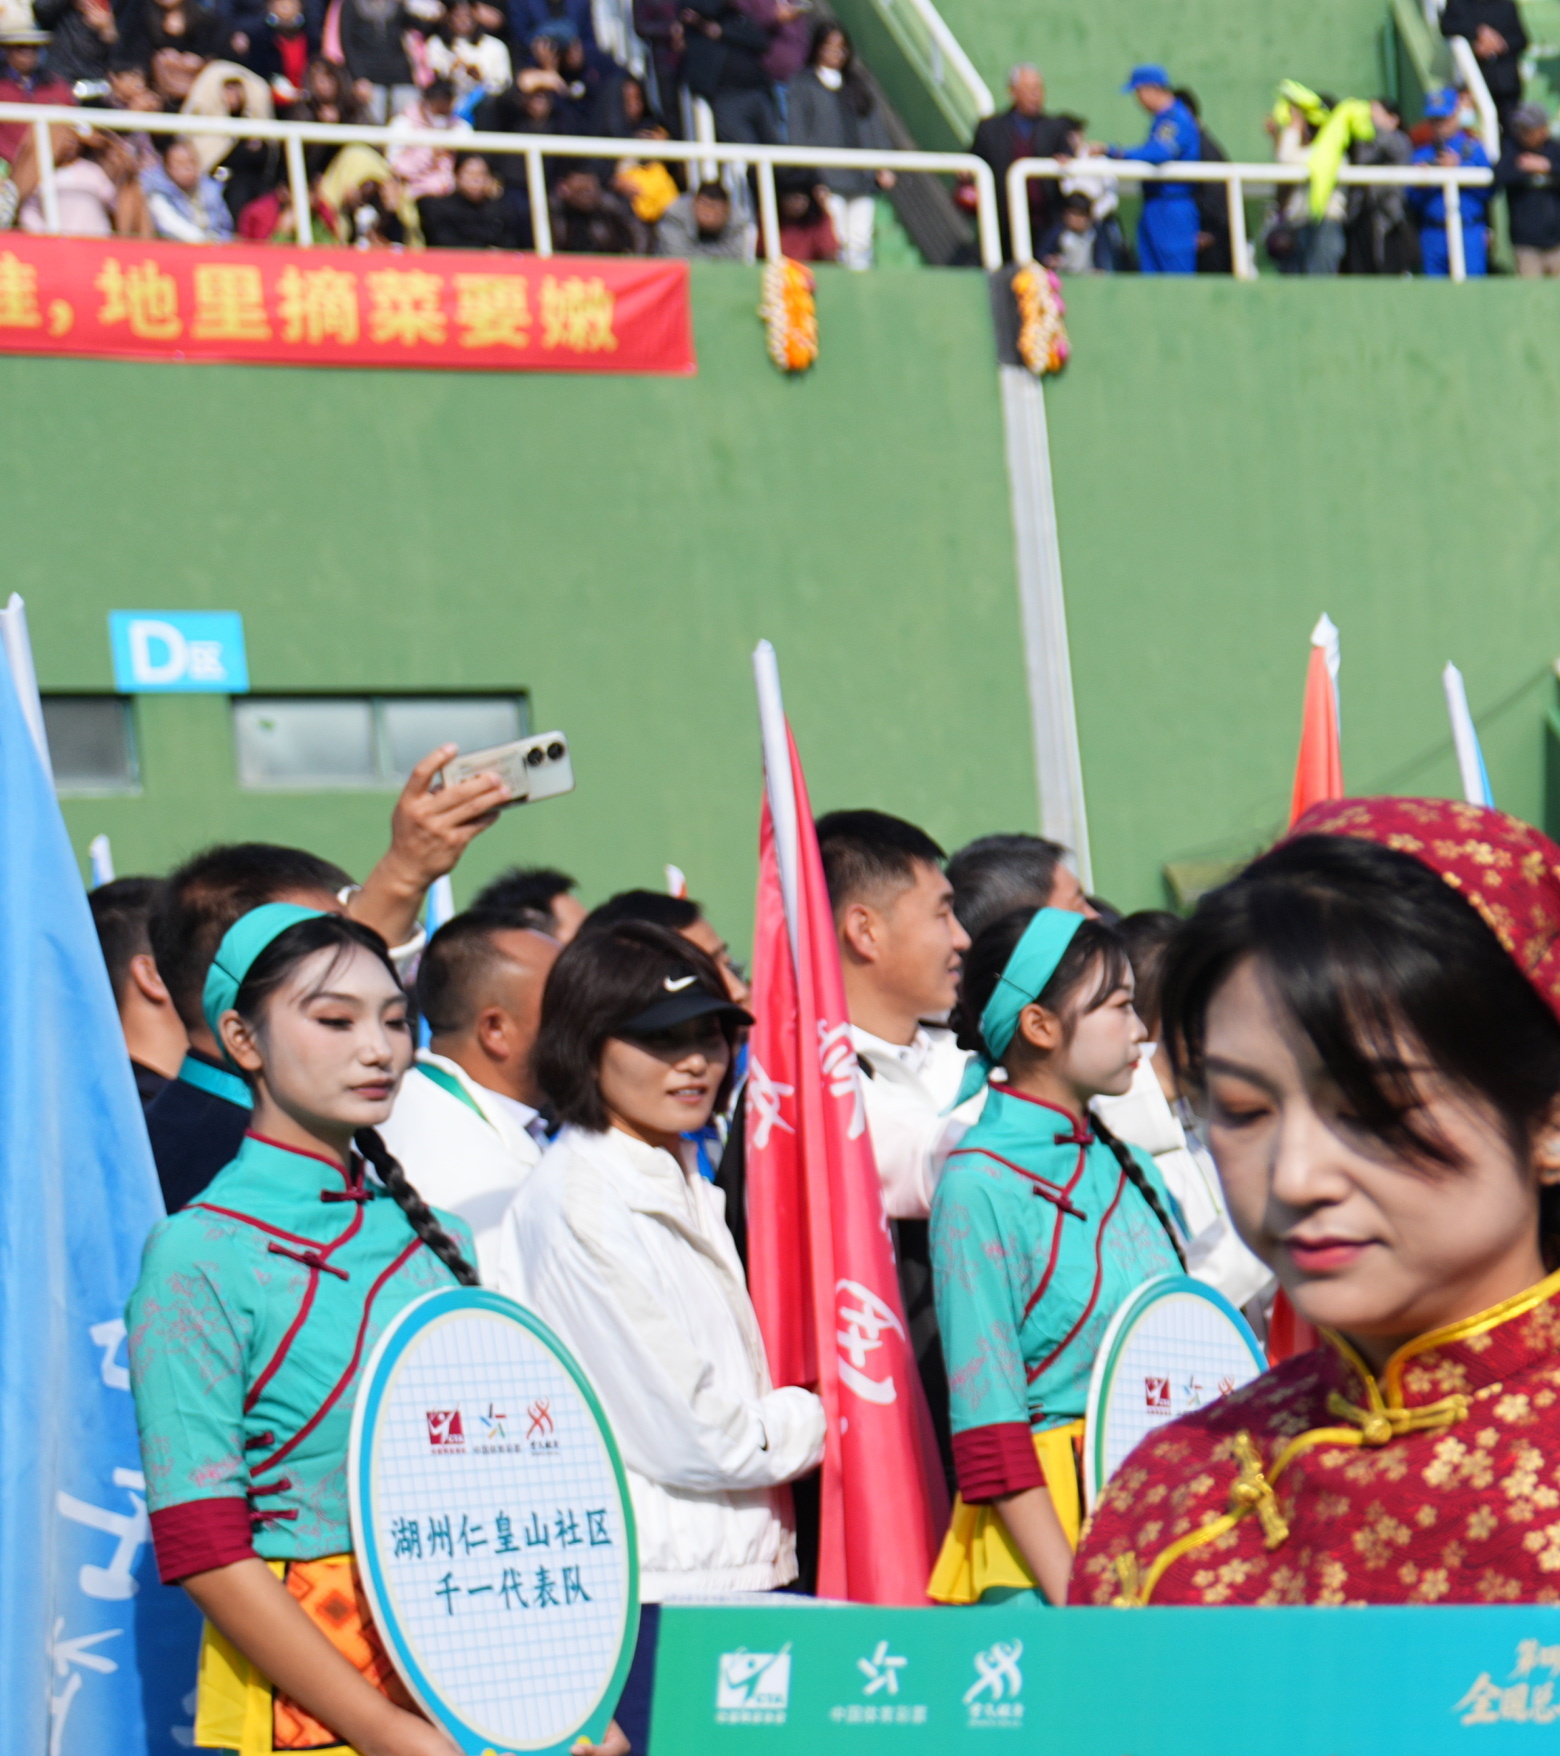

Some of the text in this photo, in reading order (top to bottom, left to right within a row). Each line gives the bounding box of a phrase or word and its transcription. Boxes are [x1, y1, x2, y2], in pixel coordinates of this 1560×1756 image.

[129, 619, 228, 685] D区
[391, 1508, 613, 1560] 湖州仁皇山社区
[434, 1564, 593, 1616] 千一代表队
